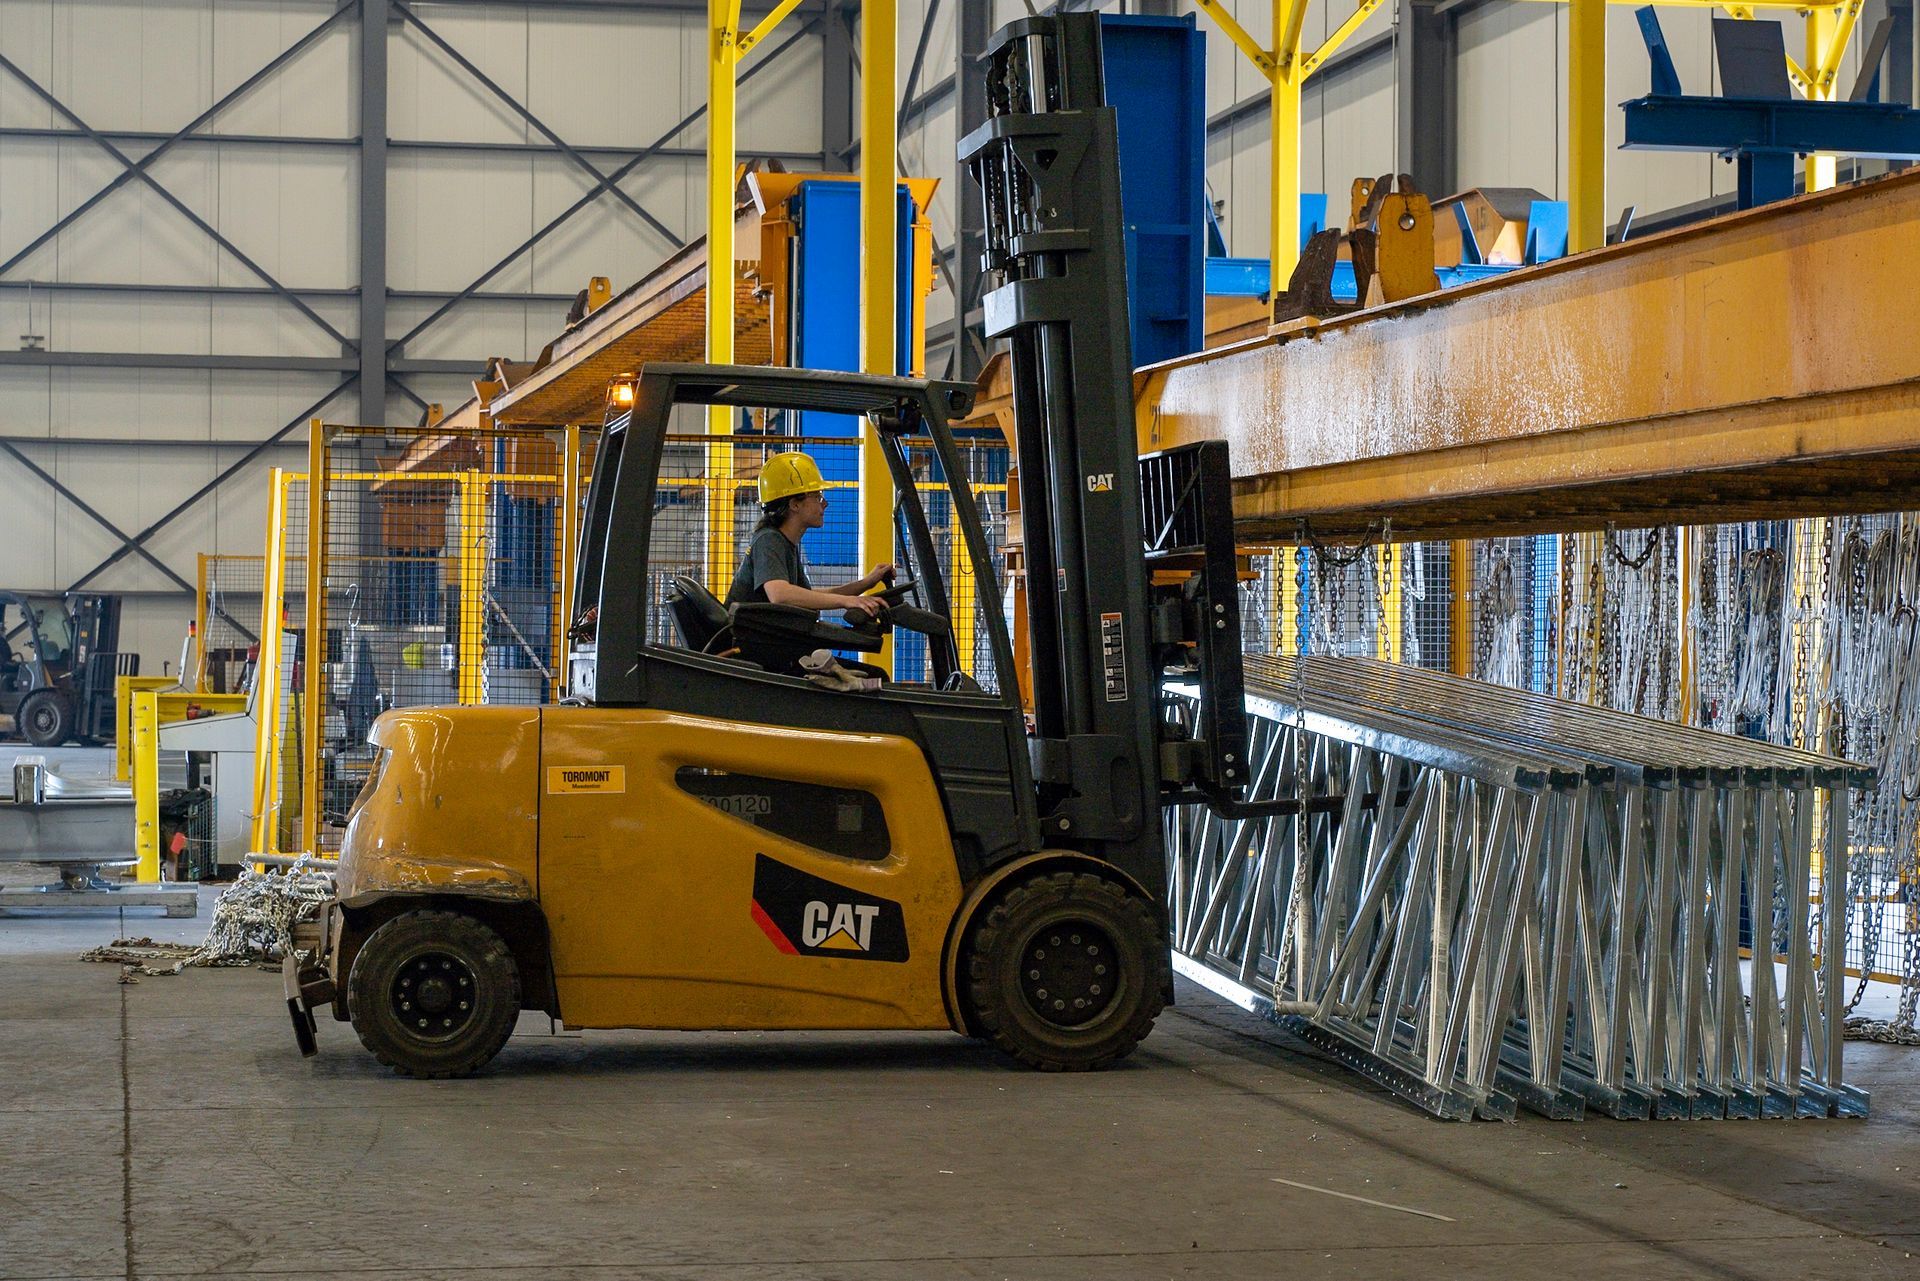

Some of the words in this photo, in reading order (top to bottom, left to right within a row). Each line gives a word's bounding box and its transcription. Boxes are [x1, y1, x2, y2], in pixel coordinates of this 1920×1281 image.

[1087, 474, 1113, 492] CAT
[562, 771, 610, 782] TOROMONT
[802, 901, 879, 951] CAT
